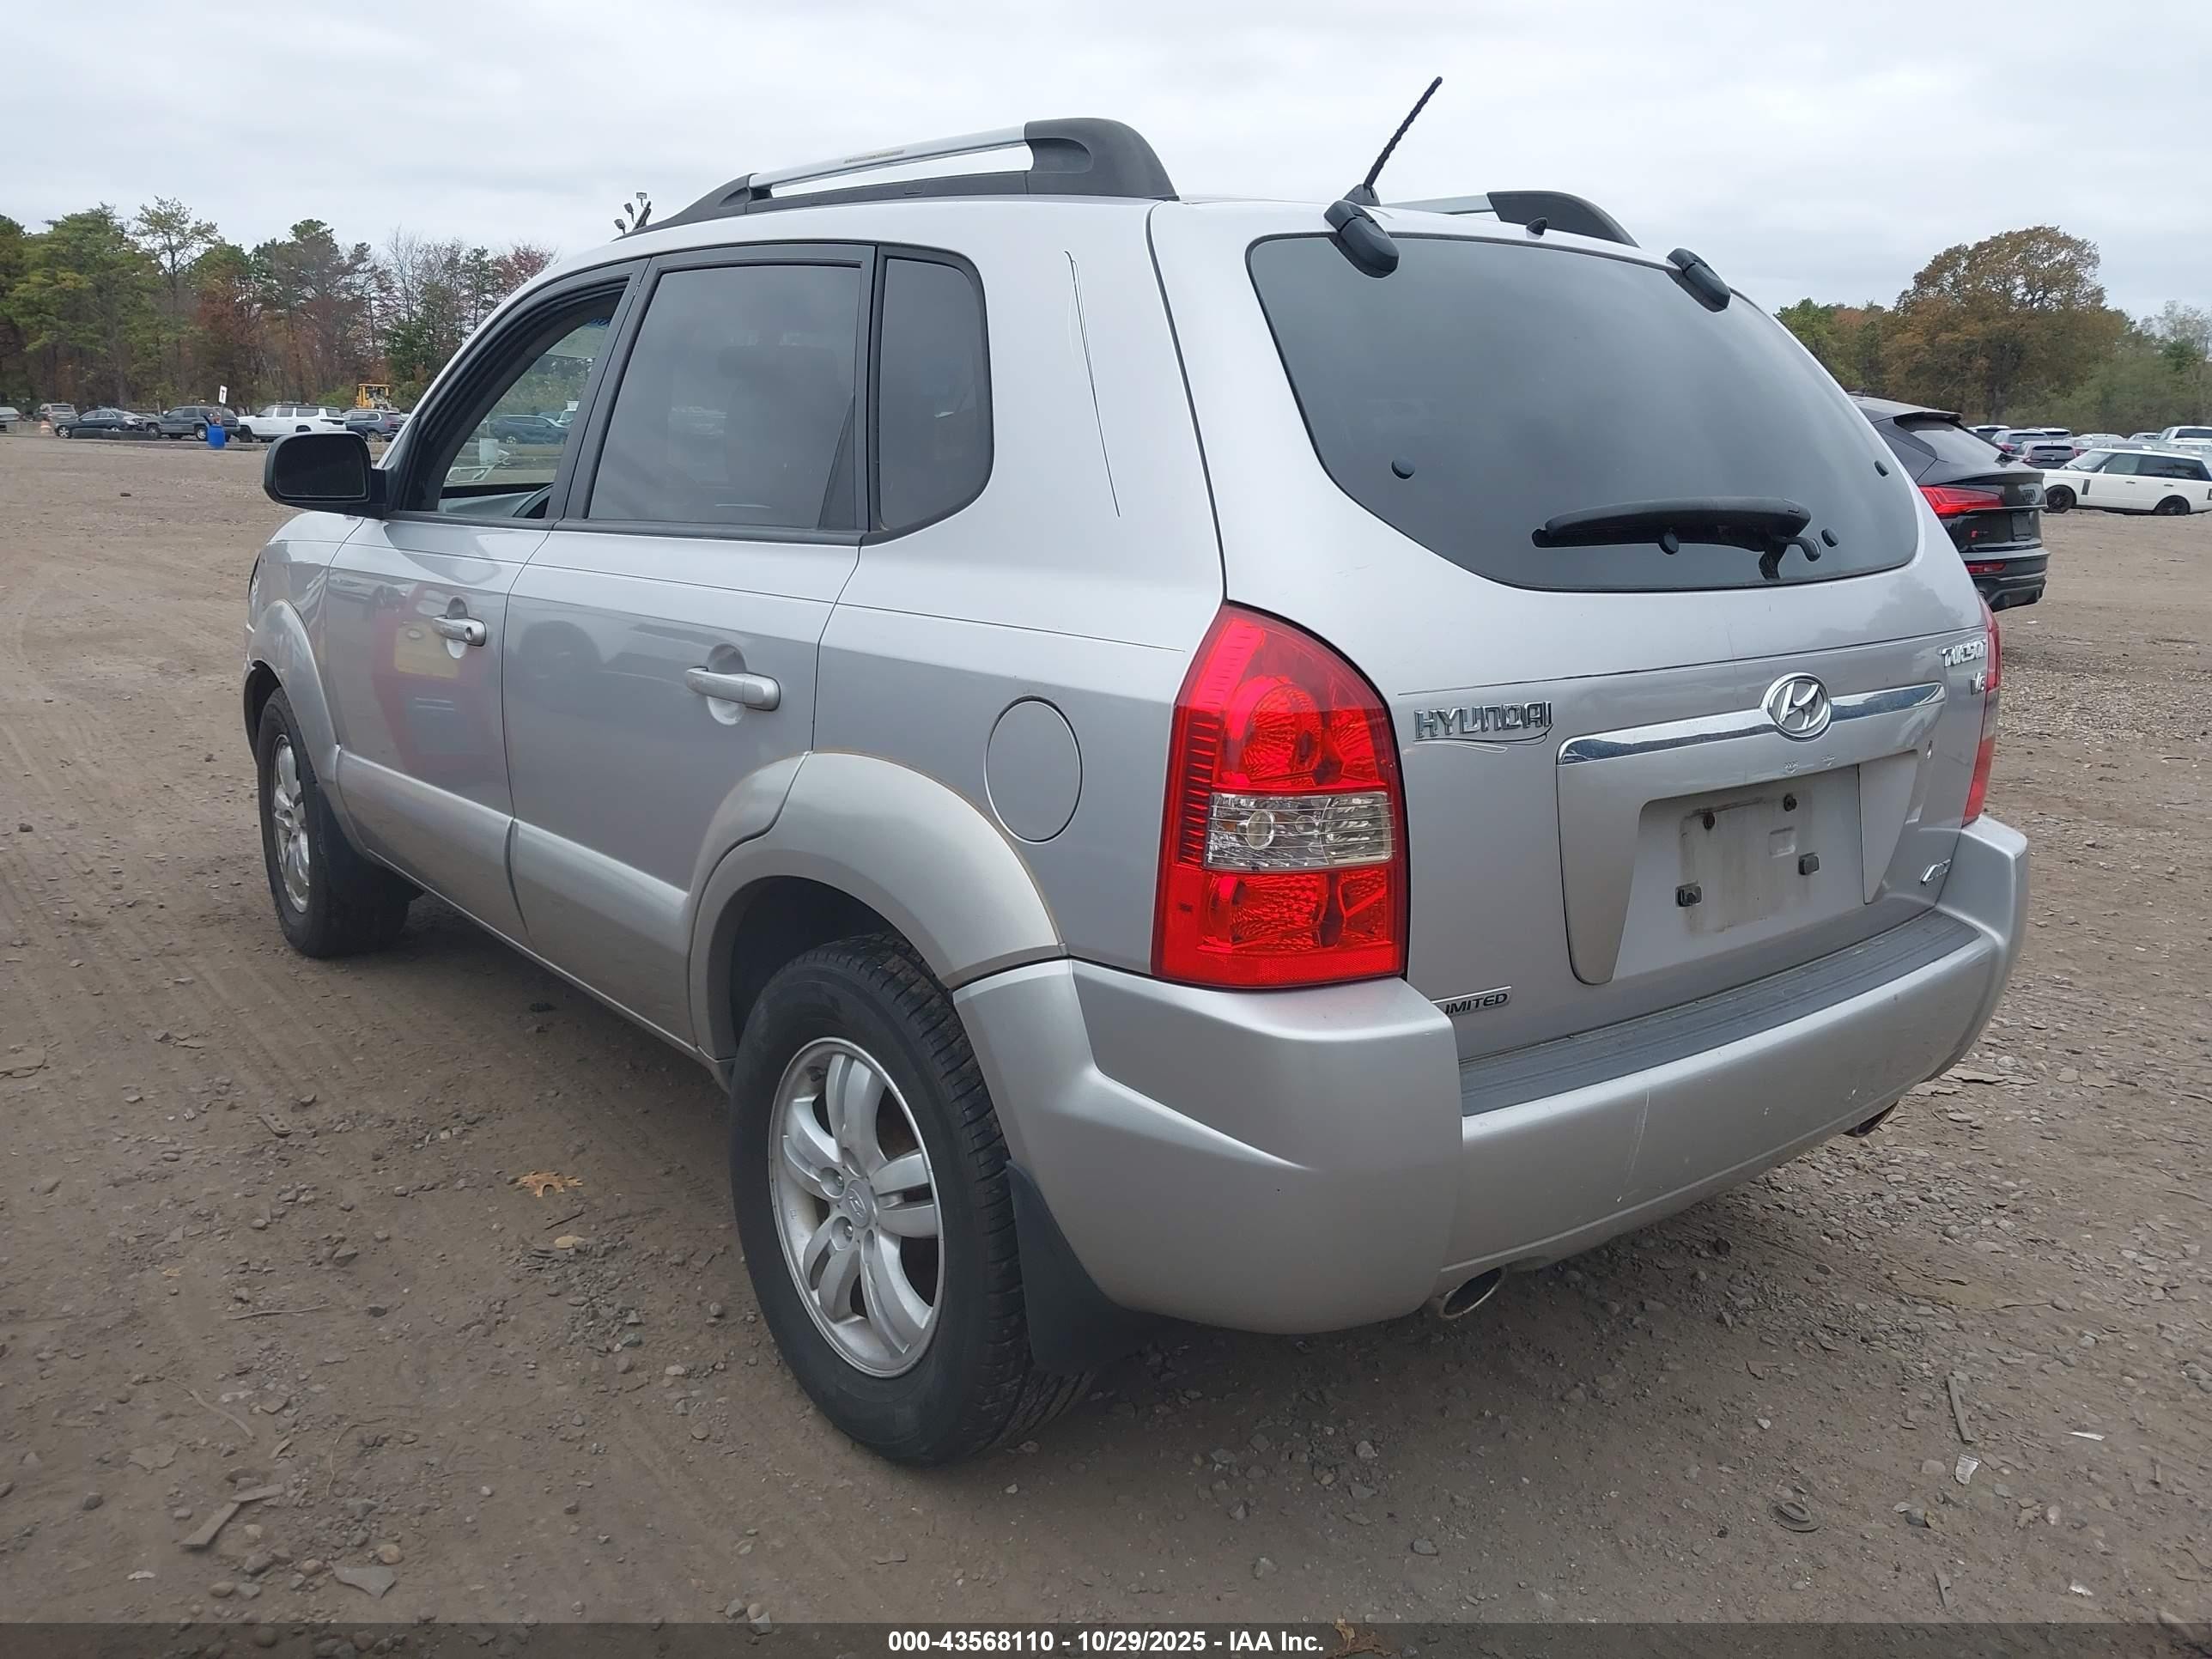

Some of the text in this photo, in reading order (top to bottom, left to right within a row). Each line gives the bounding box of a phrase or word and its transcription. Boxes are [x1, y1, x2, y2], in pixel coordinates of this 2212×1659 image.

[1942, 639, 1986, 667] TUCSO
[1414, 701, 1553, 738] HYUNDAI
[1444, 993, 1508, 1015] IMITED
